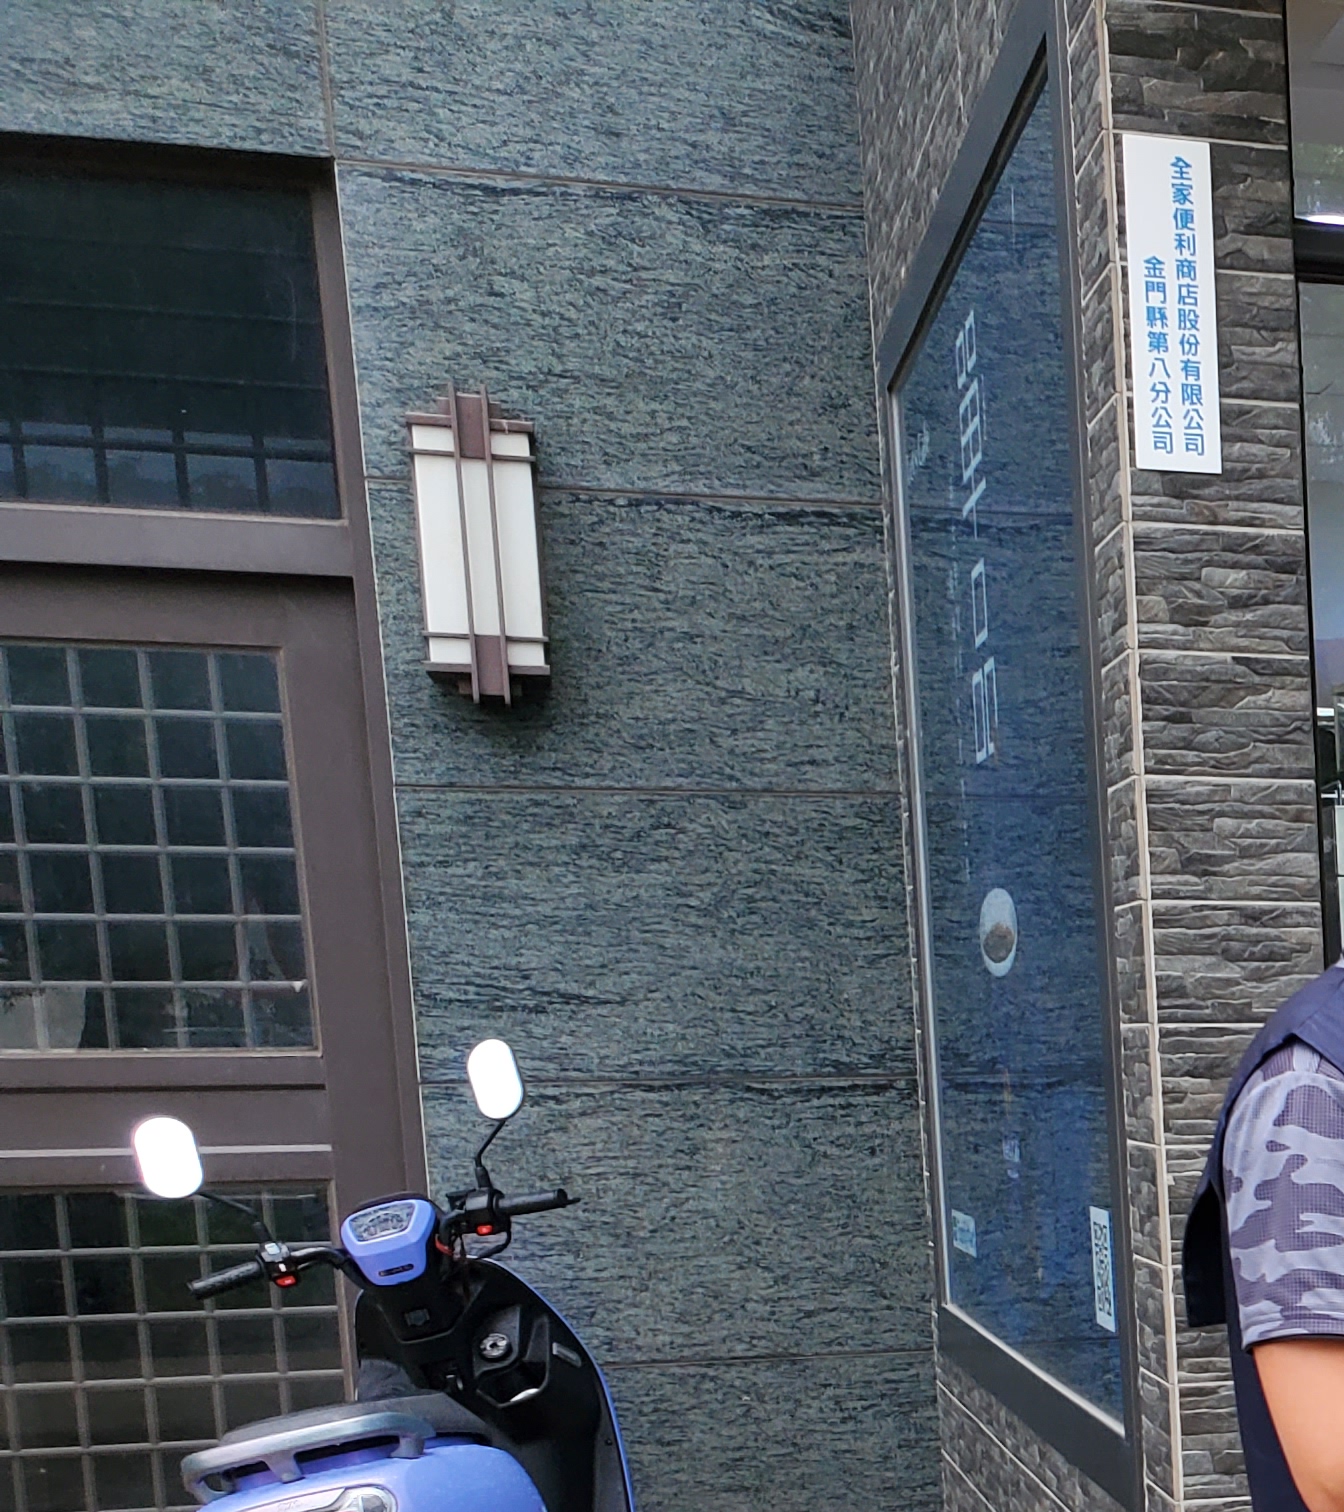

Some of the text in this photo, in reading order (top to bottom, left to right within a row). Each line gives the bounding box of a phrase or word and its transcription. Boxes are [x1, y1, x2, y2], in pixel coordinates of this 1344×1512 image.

[1143, 255, 1175, 455] 金門縣第八分公司
[1170, 156, 1206, 456] 全家便利商店股份有限公司
